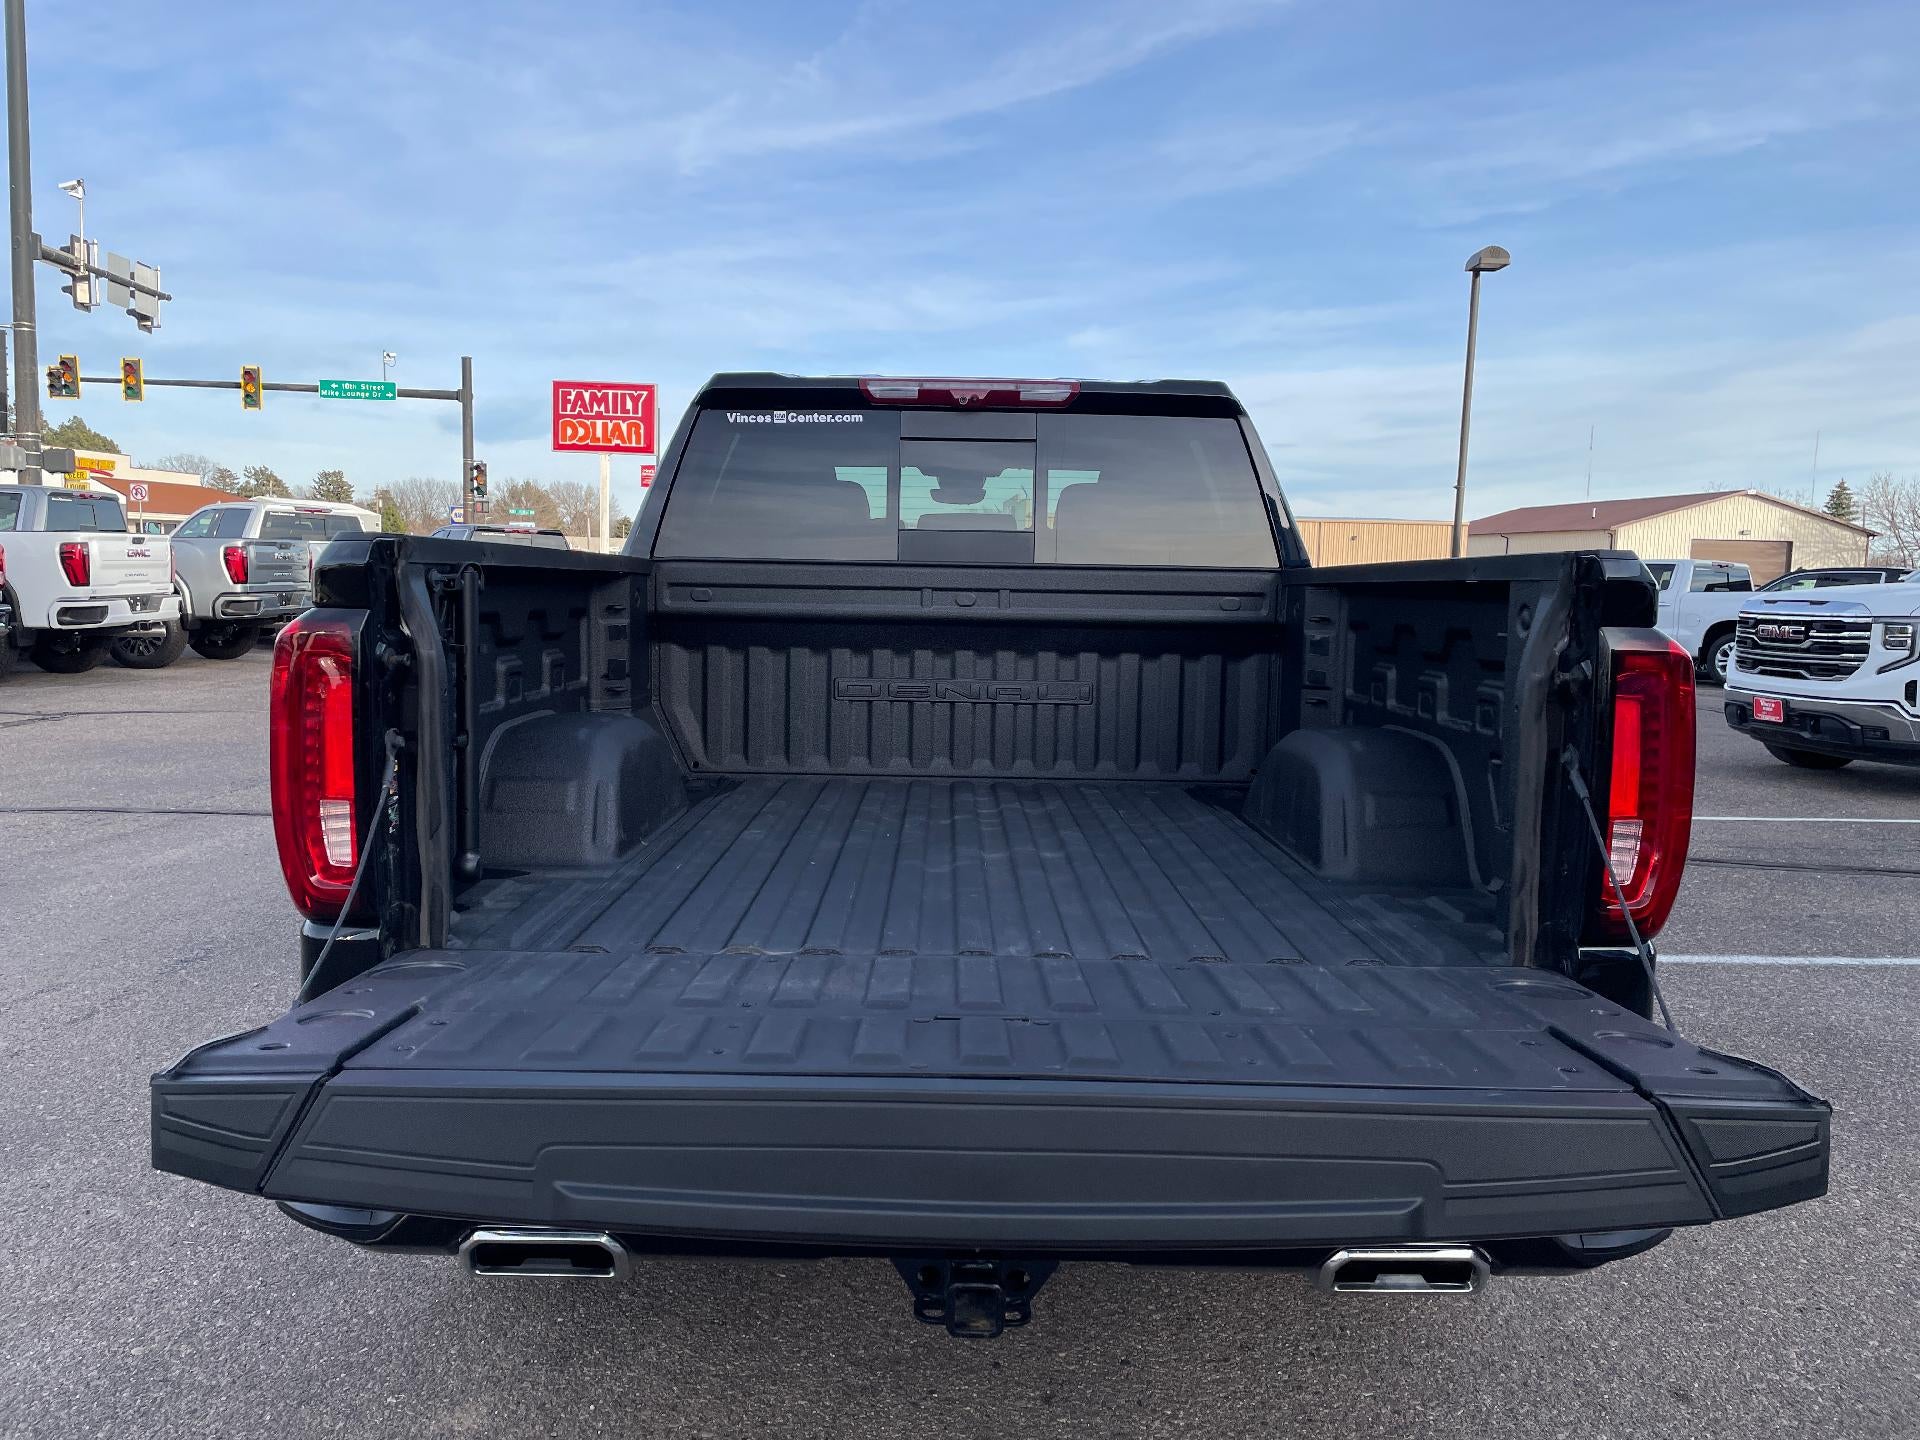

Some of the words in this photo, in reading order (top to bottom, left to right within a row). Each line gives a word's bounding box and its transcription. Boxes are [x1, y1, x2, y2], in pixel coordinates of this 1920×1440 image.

[360, 383, 384, 391] Street
[321, 389, 339, 397] Mike
[341, 391, 369, 399] Lounge
[559, 388, 648, 417] FAMILY
[788, 412, 863, 423] Center.com
[559, 418, 645, 447] DOLLAR
[127, 549, 151, 558] GMC
[1757, 624, 1805, 640] GMC
[837, 681, 1091, 701] DENALI
